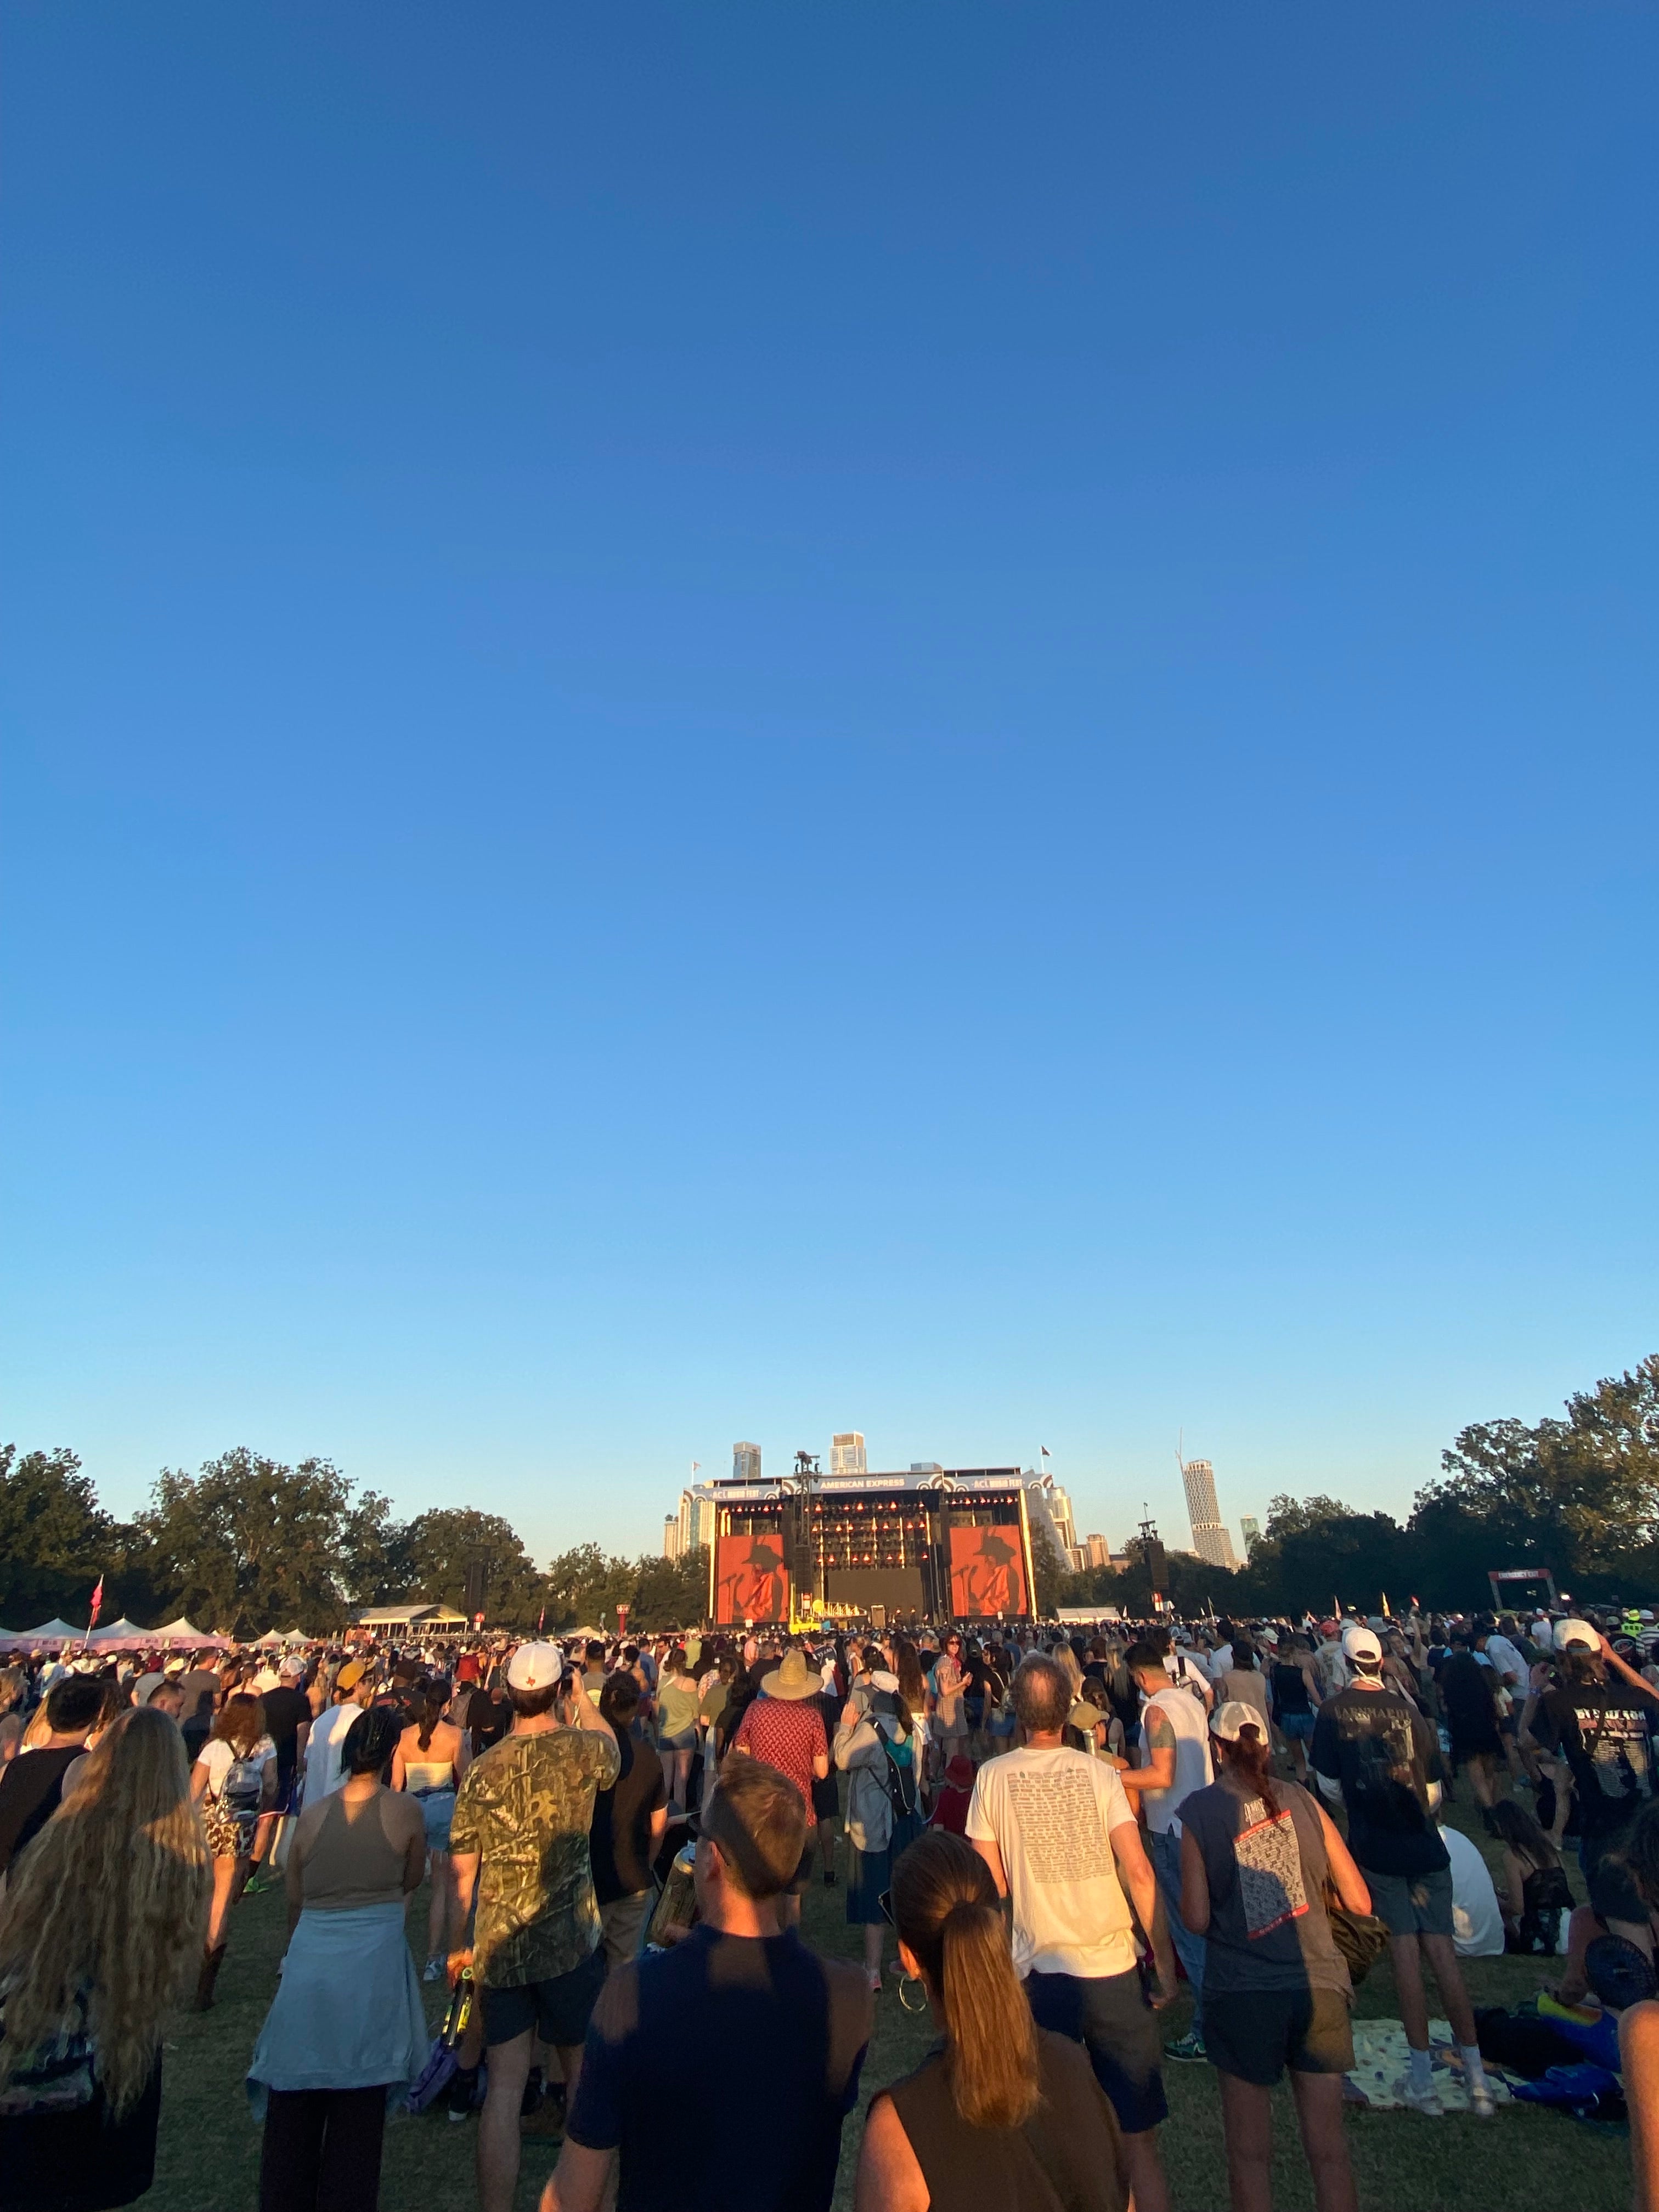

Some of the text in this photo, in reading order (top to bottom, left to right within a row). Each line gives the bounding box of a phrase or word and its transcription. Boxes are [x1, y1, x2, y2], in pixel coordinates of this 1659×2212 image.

[820, 1479, 905, 1489] AMERICAN EXPRESS
[974, 1478, 989, 1488] ACL
[1009, 1479, 1023, 1487] FEST
[713, 1489, 727, 1499] ACL
[746, 1489, 759, 1498] FEST
